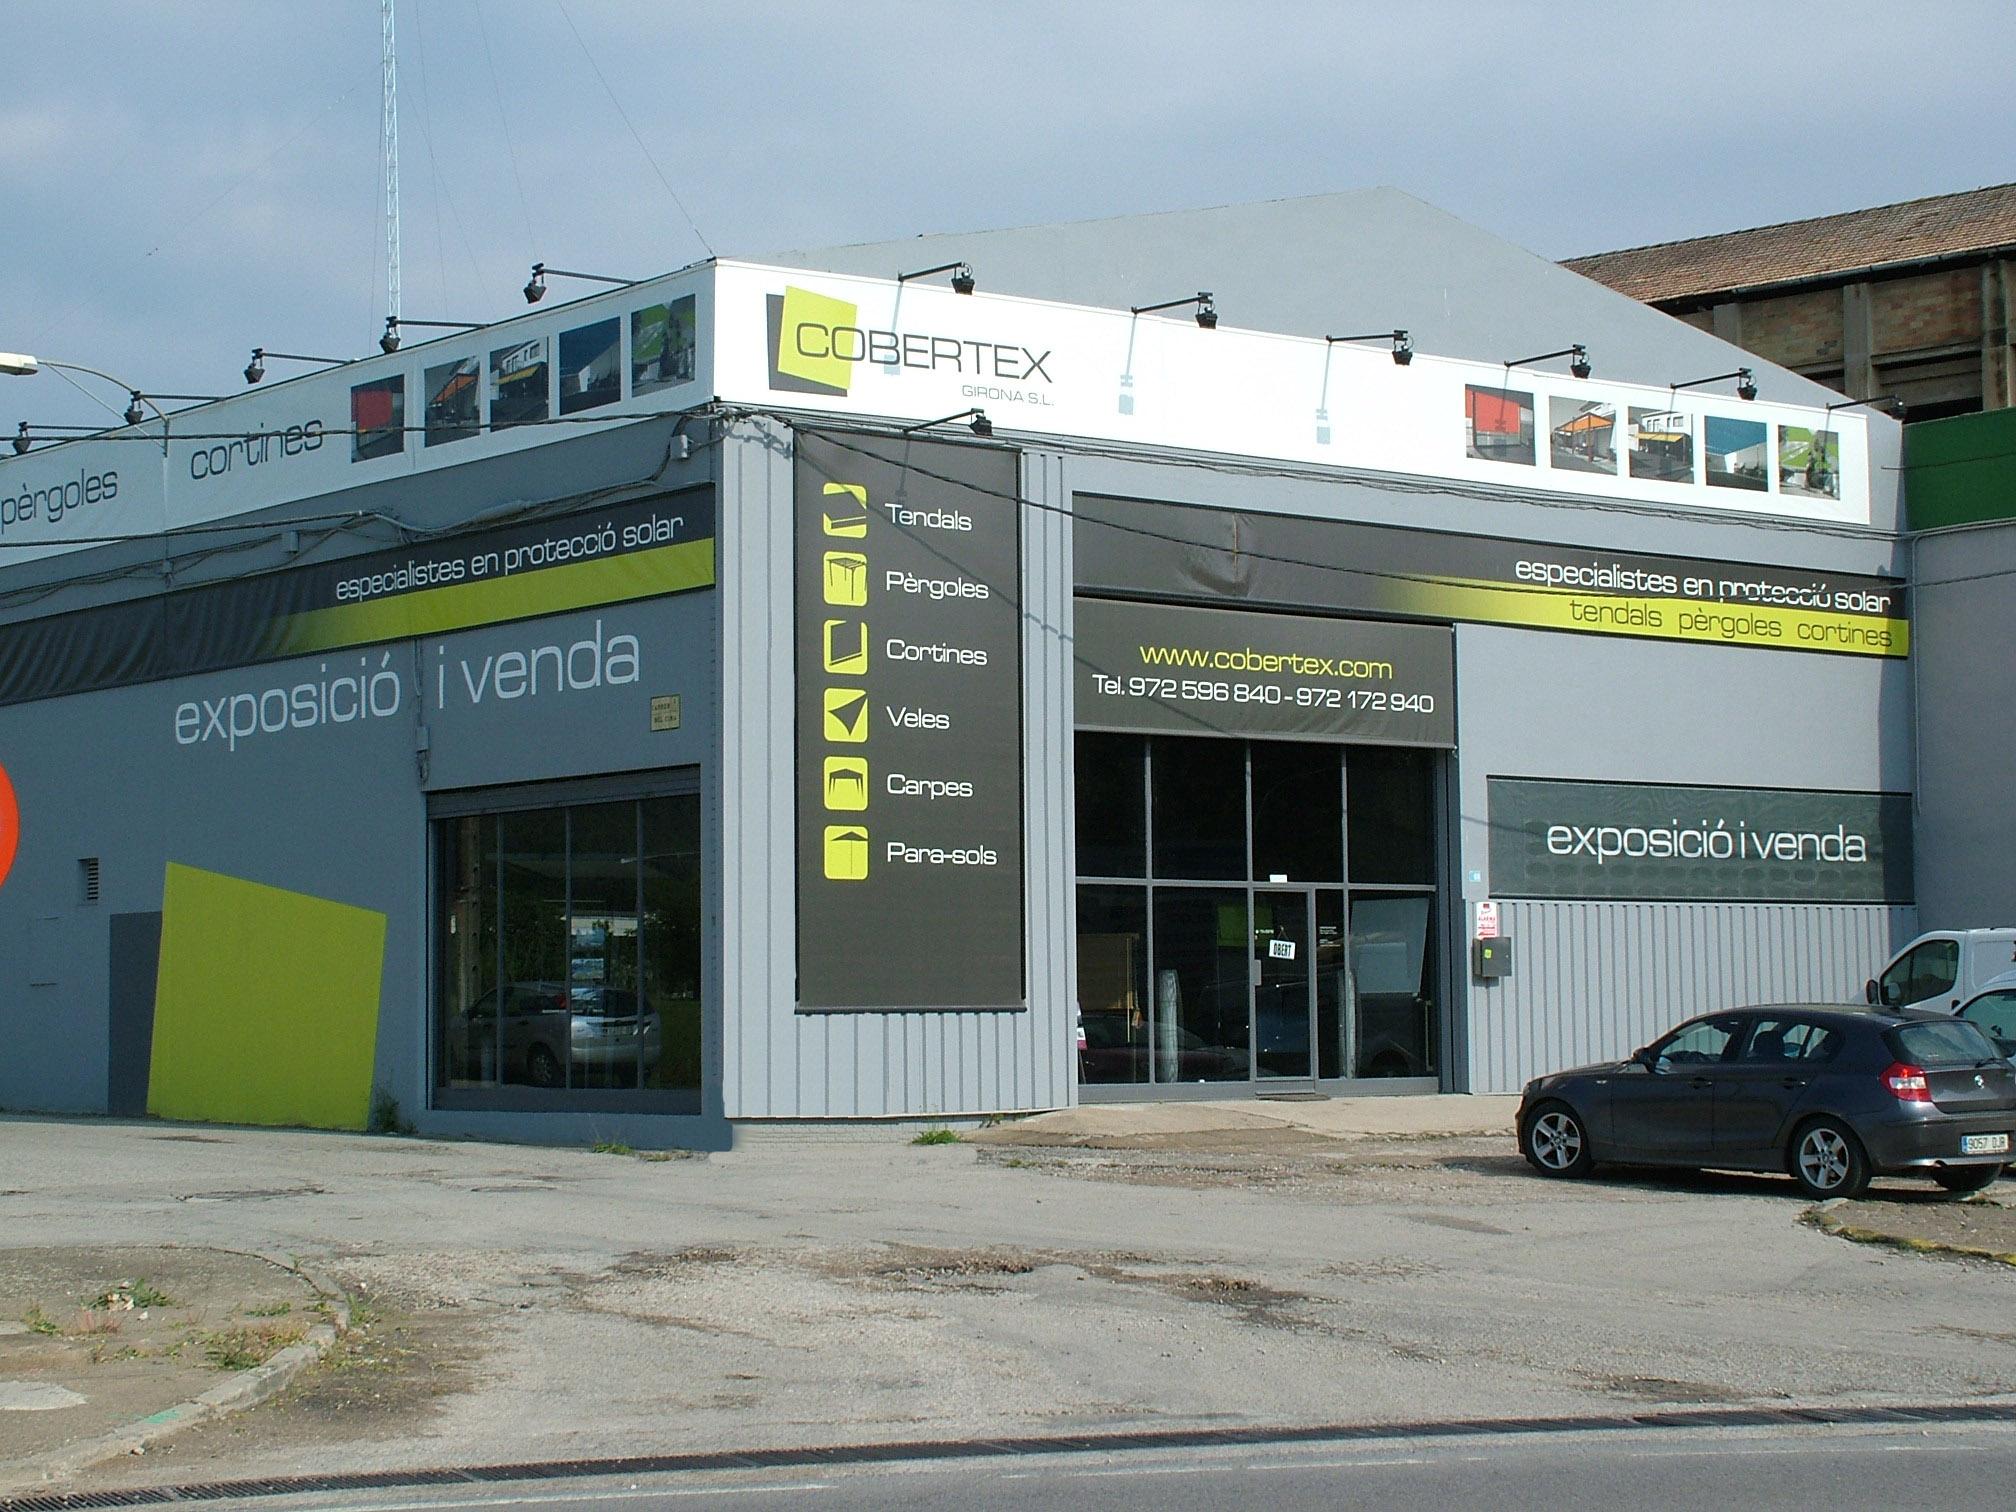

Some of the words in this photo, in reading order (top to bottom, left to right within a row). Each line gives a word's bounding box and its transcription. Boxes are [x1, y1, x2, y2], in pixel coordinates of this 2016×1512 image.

[796, 322, 1053, 384] COBERTEX
[962, 385, 1024, 402] GIRONA
[1028, 392, 1055, 406] S.L.
[191, 419, 324, 481] cortines
[0, 468, 118, 534] pèrgoles
[884, 503, 973, 531] Tendals
[336, 558, 466, 603] especialistes
[471, 552, 500, 576] en
[505, 521, 617, 576] protecció
[622, 514, 684, 548] solar
[886, 570, 989, 600] Pèrgoles
[1515, 559, 1678, 594] especialistes
[1683, 577, 1713, 596] en
[1834, 590, 1891, 613] solar
[1569, 599, 1663, 628] tendals
[1679, 607, 1782, 639] pèrgoles
[1797, 620, 1893, 647] cortines
[886, 638, 988, 666] Cortines
[1139, 645, 1393, 680] www.cobertex.com
[175, 650, 401, 752] exposició
[438, 645, 445, 709] i
[461, 619, 640, 704] venda
[1091, 673, 1126, 696] Tel.
[1129, 676, 1177, 699] 972
[1181, 680, 1229, 702] 596
[1347, 690, 1387, 711] 172
[1390, 692, 1434, 714] 940
[886, 705, 950, 730] Veles
[886, 773, 973, 801] Carpes
[887, 841, 998, 866] Para-sols
[1547, 818, 1733, 865] exposició
[1740, 820, 1746, 859] i
[1751, 824, 1867, 862] venda
[1273, 942, 1292, 957] OBERT
